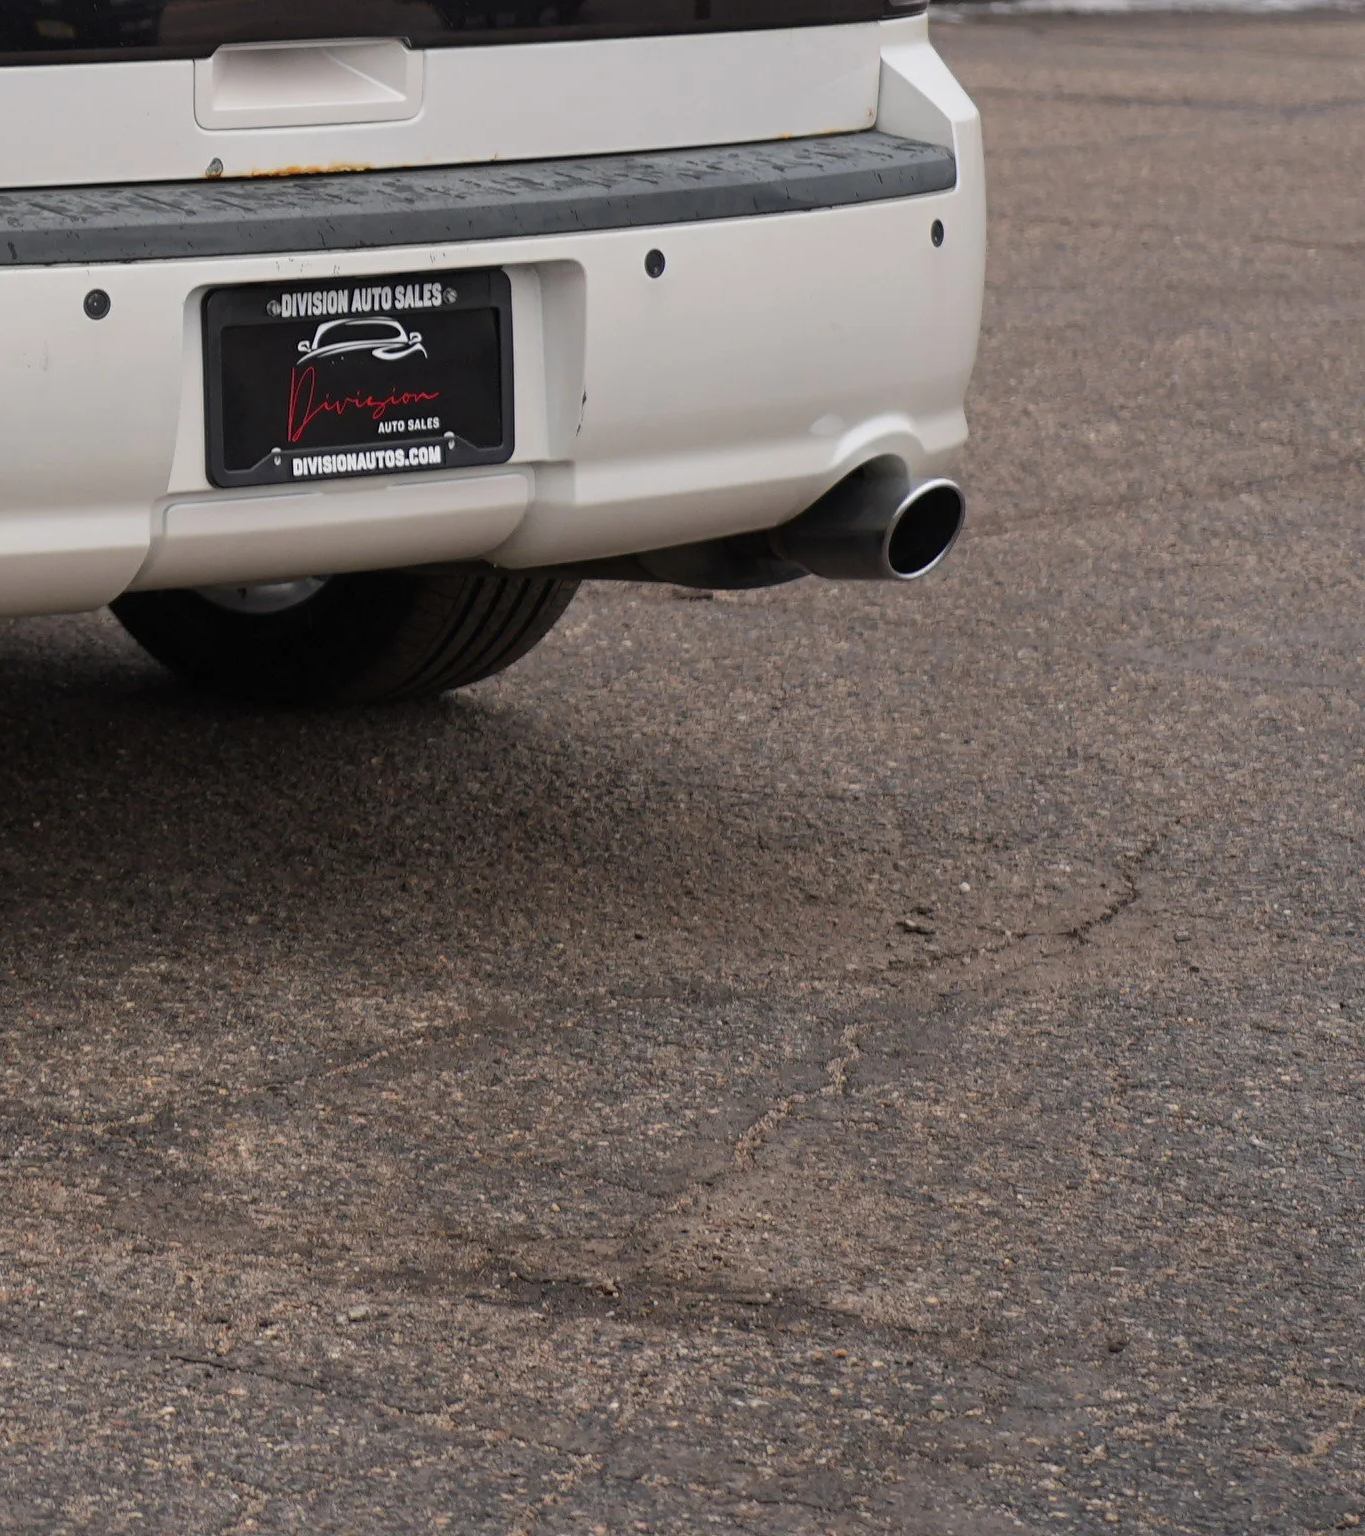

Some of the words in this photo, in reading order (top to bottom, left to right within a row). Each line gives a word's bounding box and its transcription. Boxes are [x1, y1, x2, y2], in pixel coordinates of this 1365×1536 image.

[281, 289, 349, 318] DIVISION
[351, 285, 392, 313] AUTO
[394, 282, 443, 310] SALES
[378, 419, 405, 434] AUTO
[407, 416, 440, 431] SALES
[292, 445, 442, 477] DIVISIONAUTOS.COM
